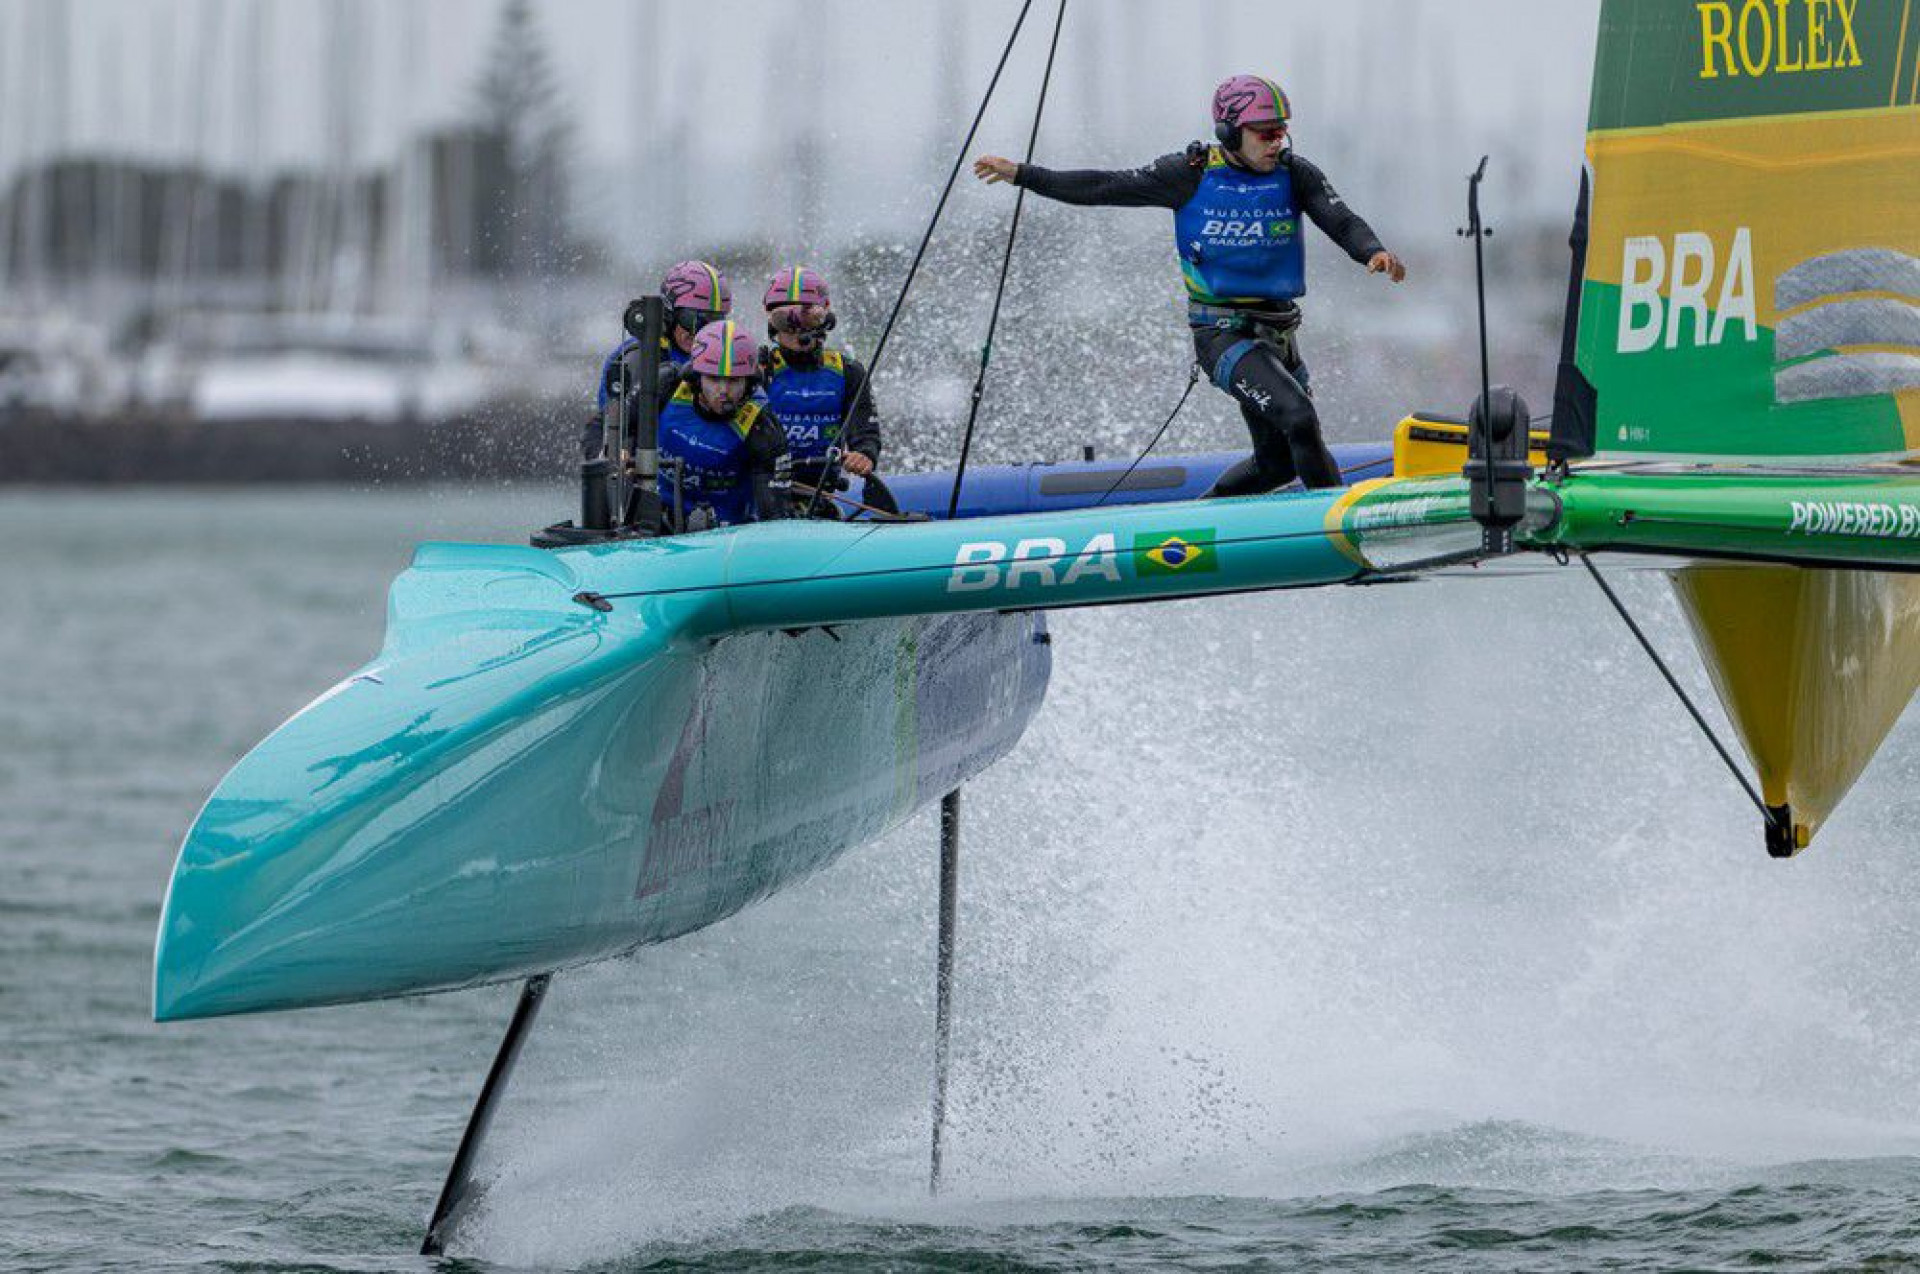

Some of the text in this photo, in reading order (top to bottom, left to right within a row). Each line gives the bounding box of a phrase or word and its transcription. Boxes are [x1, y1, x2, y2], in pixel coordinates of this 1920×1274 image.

[1696, 0, 1863, 78] ROLEX
[1201, 220, 1264, 237] BRA
[1203, 208, 1292, 218] MUBADALA
[1616, 227, 1758, 354] BRA
[782, 425, 819, 440] RA
[1788, 501, 1898, 536] POWERED
[948, 532, 1121, 592] BRA
